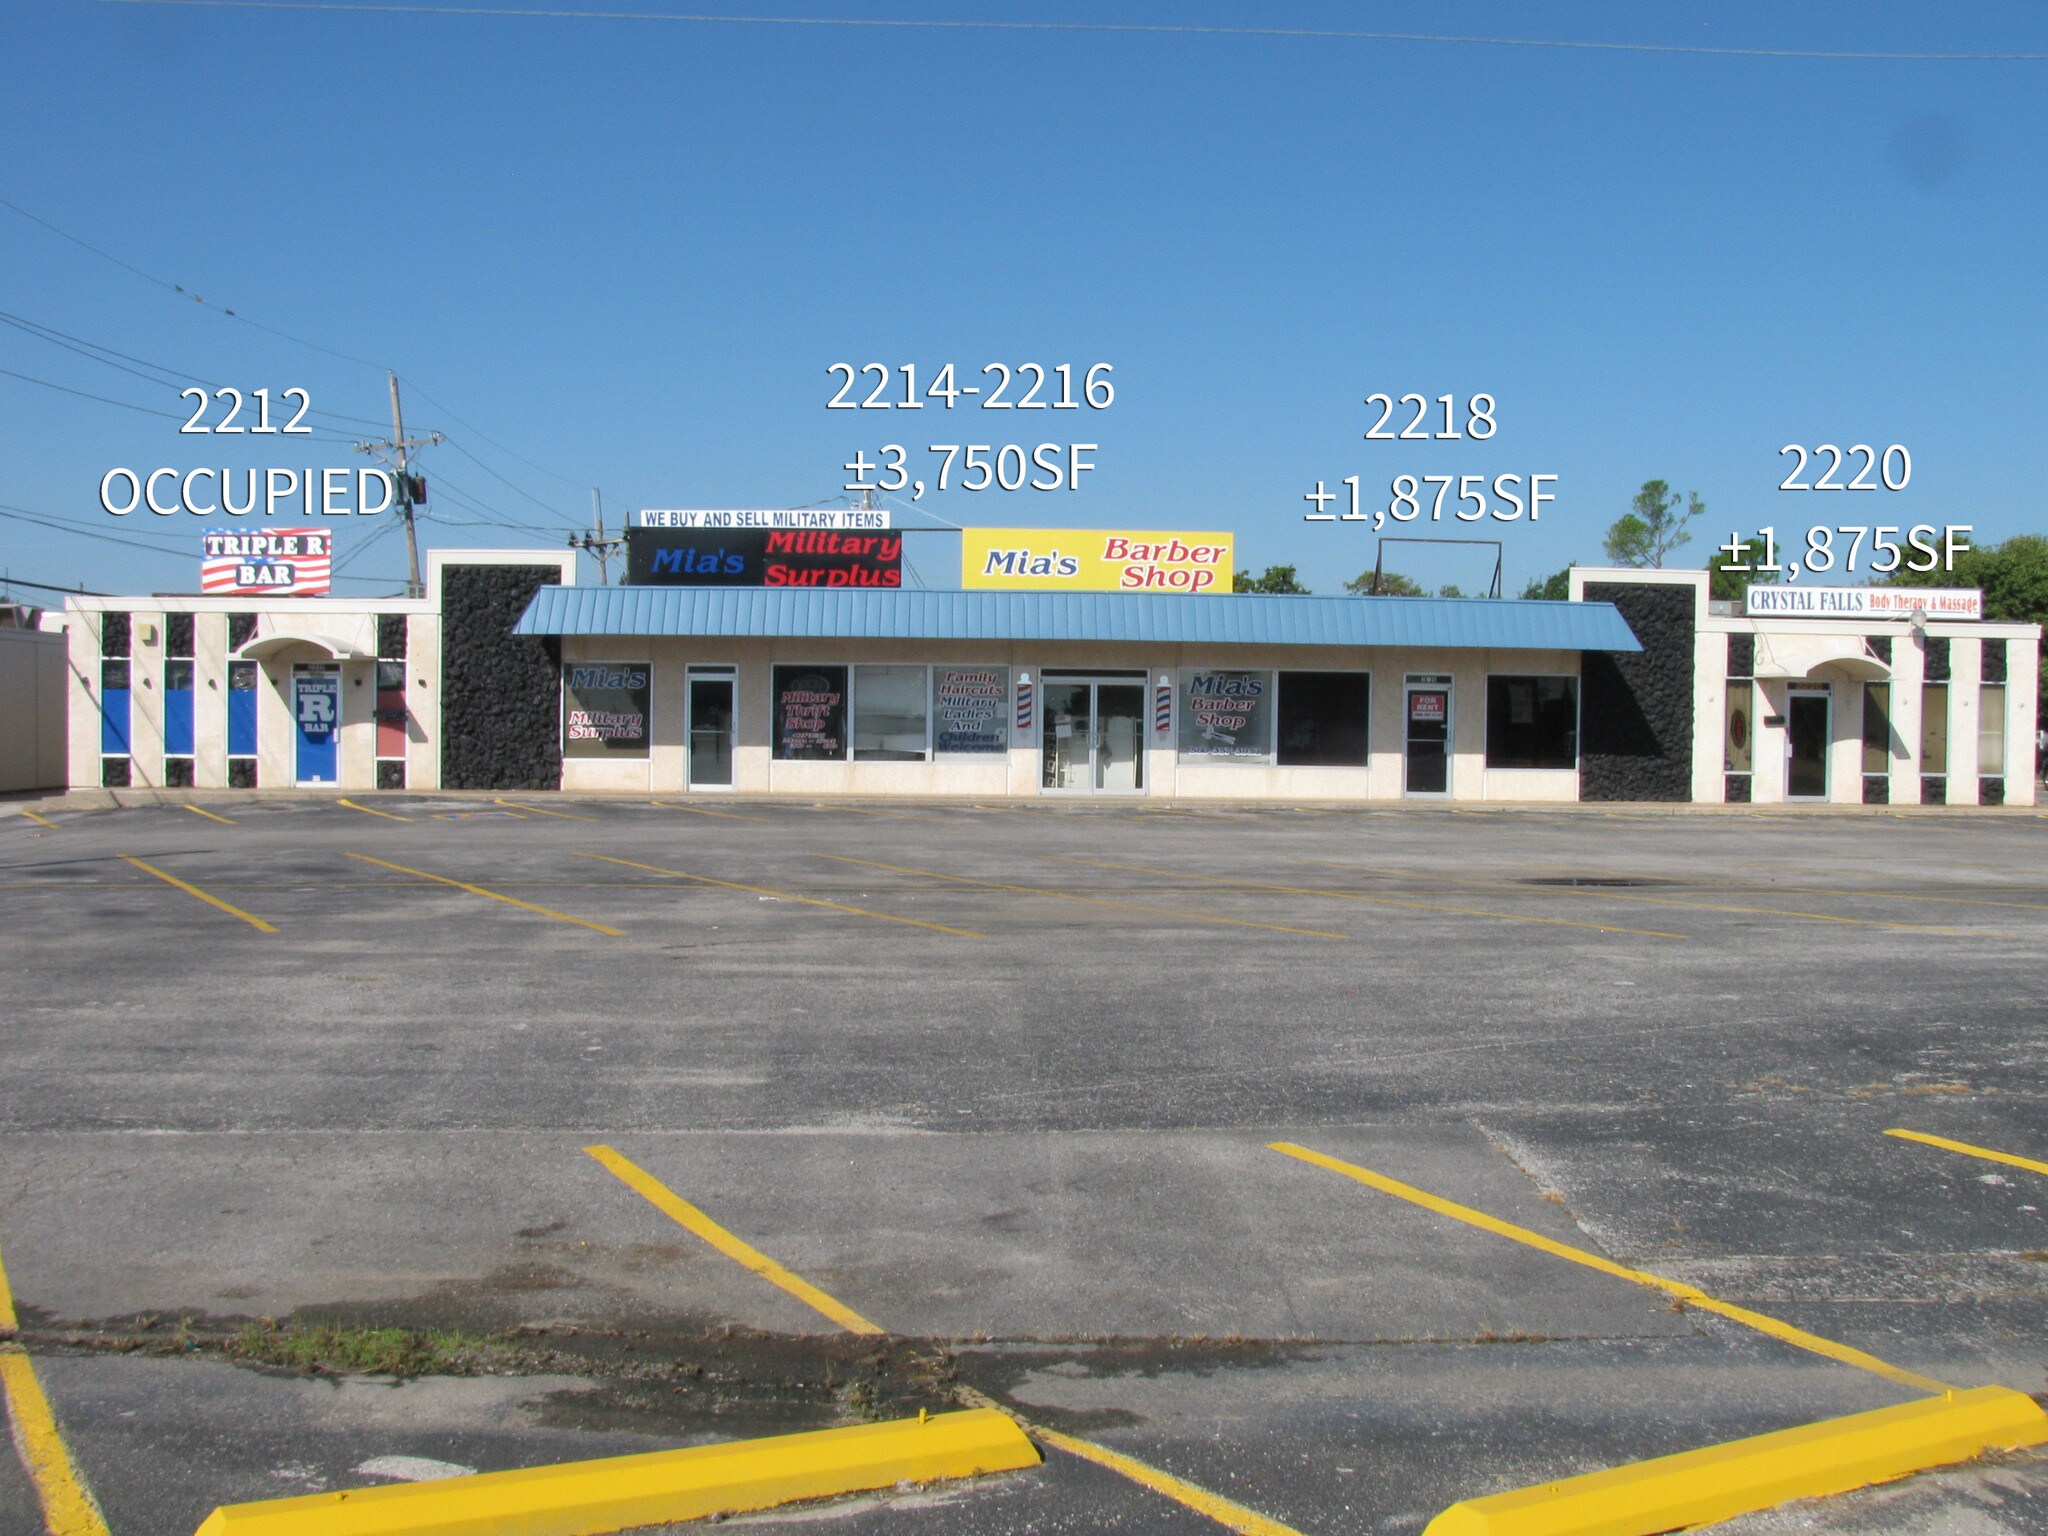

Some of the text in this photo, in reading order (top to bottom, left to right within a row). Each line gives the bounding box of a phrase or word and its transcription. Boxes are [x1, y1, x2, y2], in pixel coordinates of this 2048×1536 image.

[645, 511, 883, 528] WE BUY AND SELL MILITARY ITEMS
[207, 535, 325, 556] TRIPLE R
[764, 530, 902, 560] Military
[1103, 538, 1226, 564] Barber
[650, 548, 745, 574] Mia's
[983, 550, 1078, 576] Mia's
[238, 564, 293, 585] BAR
[764, 565, 901, 588] Surplus
[1121, 565, 1214, 593] Shop
[1751, 590, 1864, 612] CRYSTAL FALLS
[1869, 594, 1978, 613] Body Therapy & Massage
[571, 667, 647, 690] Mia's
[944, 672, 998, 685] Family
[1188, 675, 1263, 697] Mia's
[297, 684, 337, 693] TRIPLE
[939, 684, 1004, 697] Haircuts
[780, 691, 840, 705] Military
[939, 696, 998, 709] Military
[1190, 698, 1255, 712] Barber
[1419, 697, 1437, 705] FOR
[298, 694, 335, 722] R
[785, 705, 831, 718] Thrift
[942, 709, 994, 720] Ladies
[304, 723, 330, 733] BAR
[569, 711, 643, 729] Military
[784, 717, 826, 731] Shop
[949, 720, 983, 733] And
[1196, 713, 1246, 730] Shop
[568, 725, 642, 741] Surplus
[938, 732, 1000, 744] Children
[937, 742, 1004, 754] Welcome
